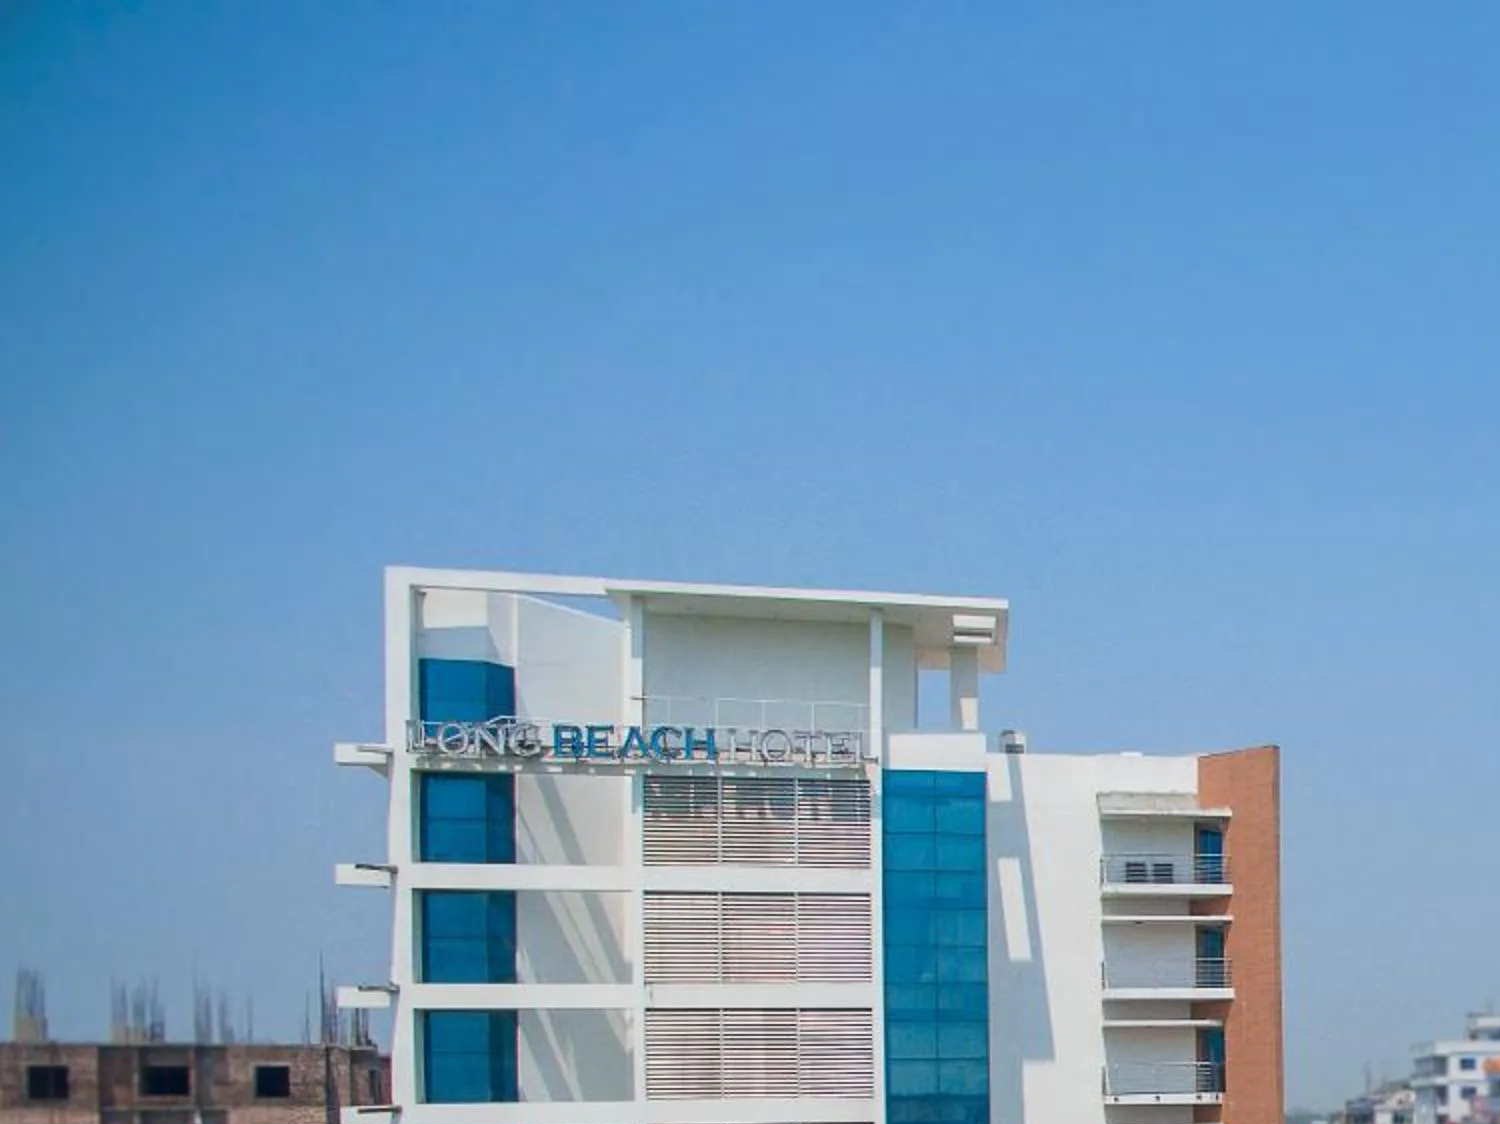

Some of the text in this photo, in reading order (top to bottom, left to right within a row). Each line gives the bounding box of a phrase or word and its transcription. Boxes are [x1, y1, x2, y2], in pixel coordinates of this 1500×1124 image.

[406, 719, 877, 766] LONG BEACH HOTEL
